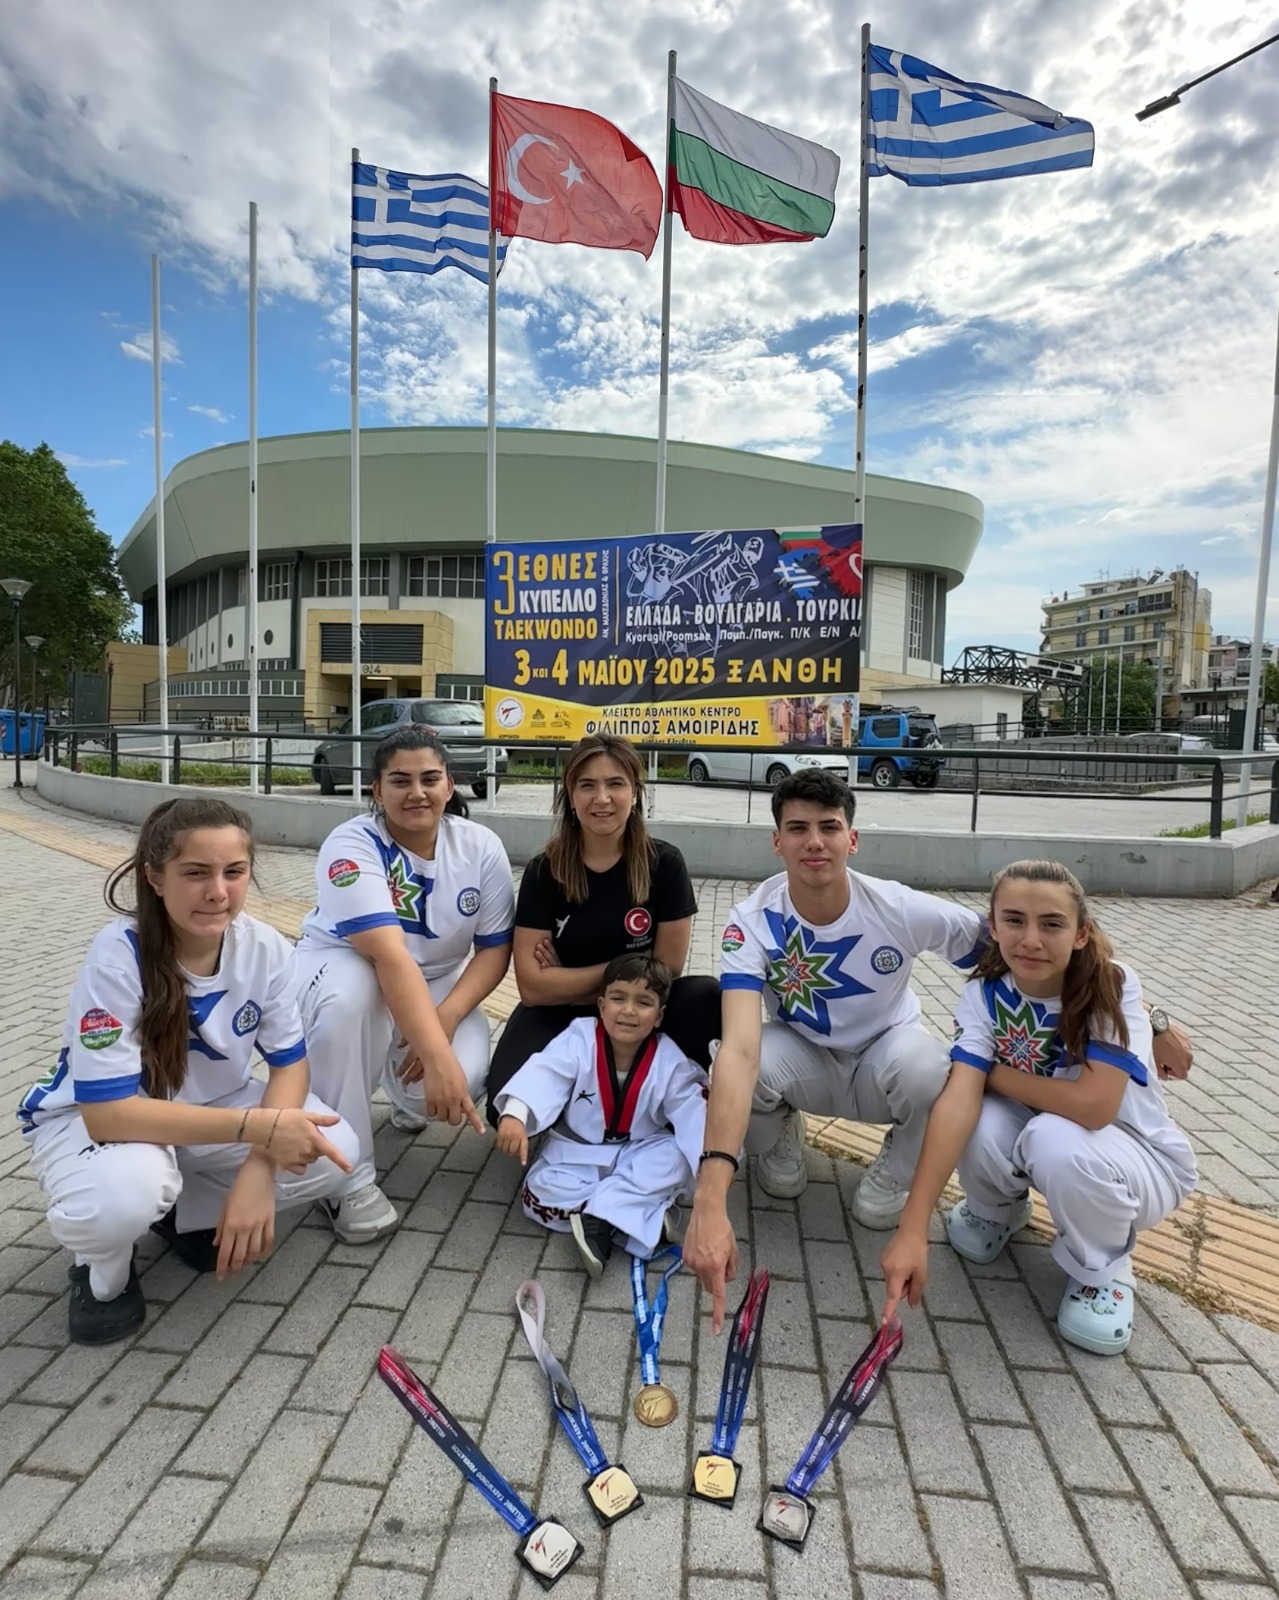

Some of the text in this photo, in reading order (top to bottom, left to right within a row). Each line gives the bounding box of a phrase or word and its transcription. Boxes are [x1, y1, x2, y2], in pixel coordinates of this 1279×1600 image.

[493, 550, 597, 615] 3 ΕΘΝΕΣ
[519, 587, 597, 614] ΚΥΠΕΛΛΟ
[625, 604, 681, 627] ΕΛΛΑΔΑ
[694, 600, 782, 625] ΒΟΥΛΓΑΡΙΑ
[494, 617, 598, 640] TAEKWONDO
[513, 649, 842, 686] 3 και 4 ΜΑΪΟΥ 2025 ΞΑΝΘΗ
[602, 707, 741, 717] ΚΛΕΙΣΤΟ ΑΘΛΗΤΙΚΟ ΚΕΝΤΡΟ
[586, 720, 759, 736] ΦΙΛΙΠΠΟΣ ΑΜΟΙΡΙΔΗΣ
[450, 1443, 478, 1473] FEDERATION
[475, 1470, 505, 1501] TAEKWONDO
